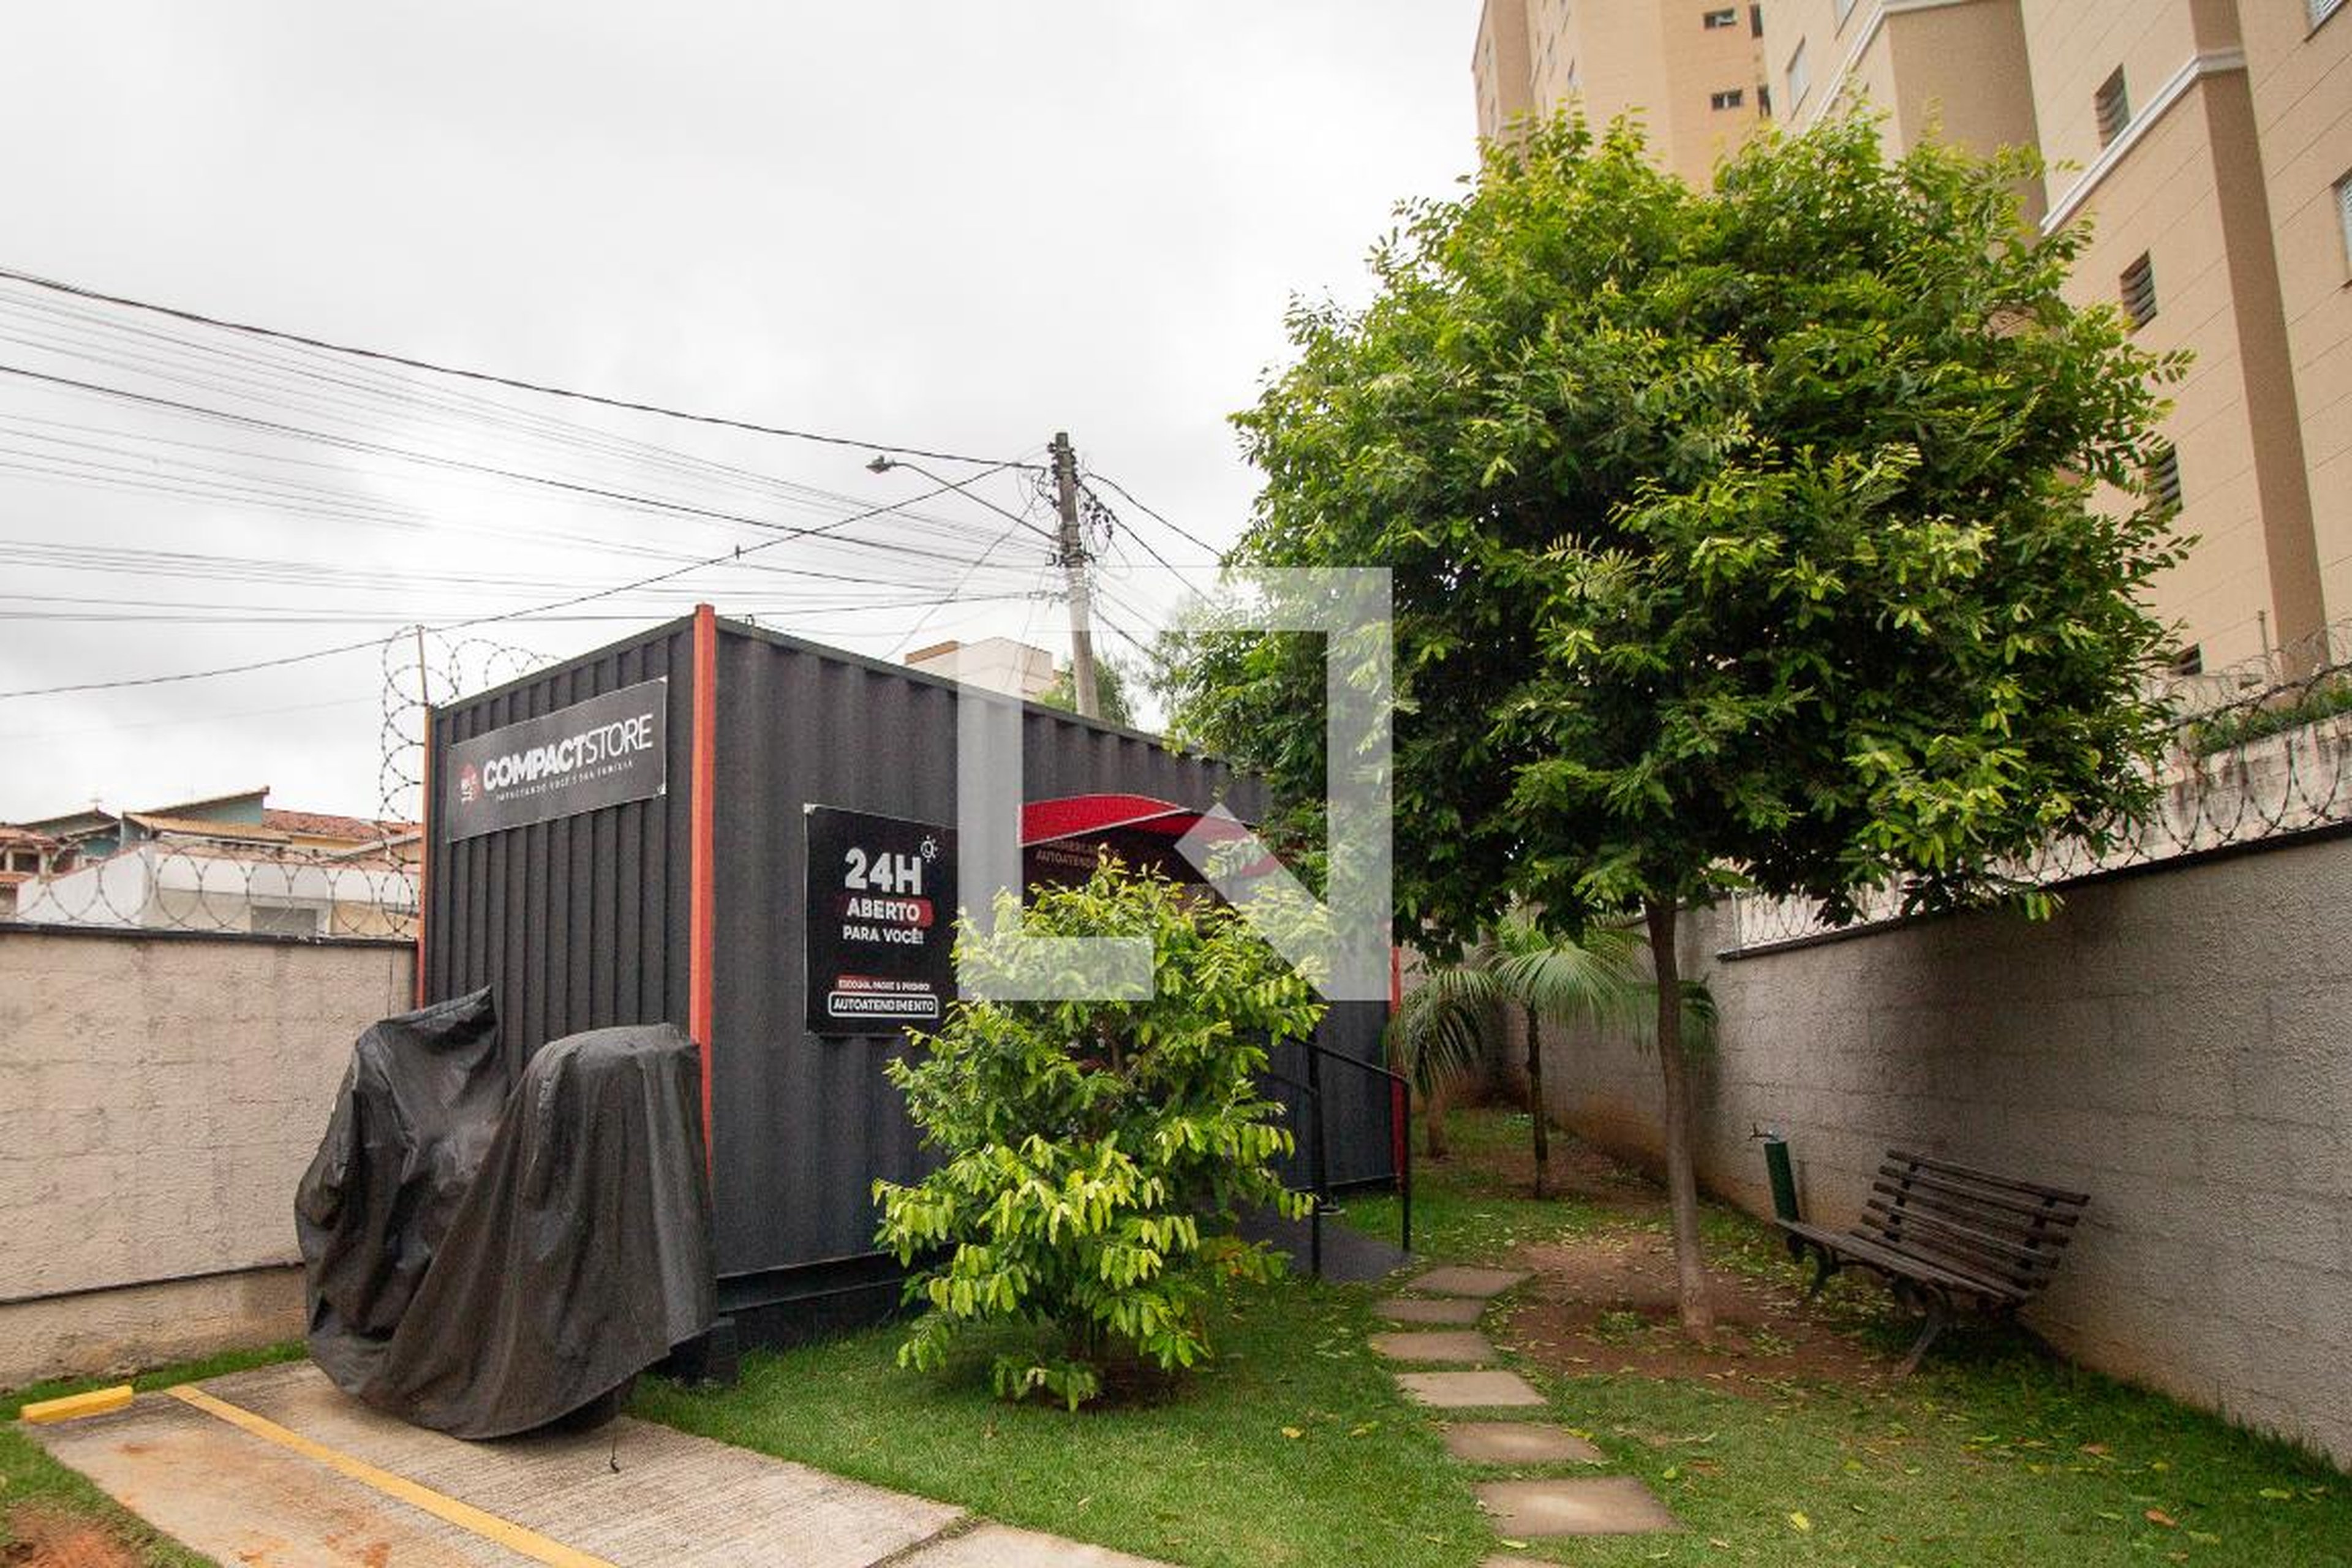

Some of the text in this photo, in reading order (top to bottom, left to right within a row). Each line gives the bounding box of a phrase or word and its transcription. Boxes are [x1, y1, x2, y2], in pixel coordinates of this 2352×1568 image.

[845, 848, 922, 895] 24H
[846, 897, 921, 921] ABERTO
[843, 925, 880, 942] PARA
[833, 997, 934, 1012] AUTOATENDIMENTO
